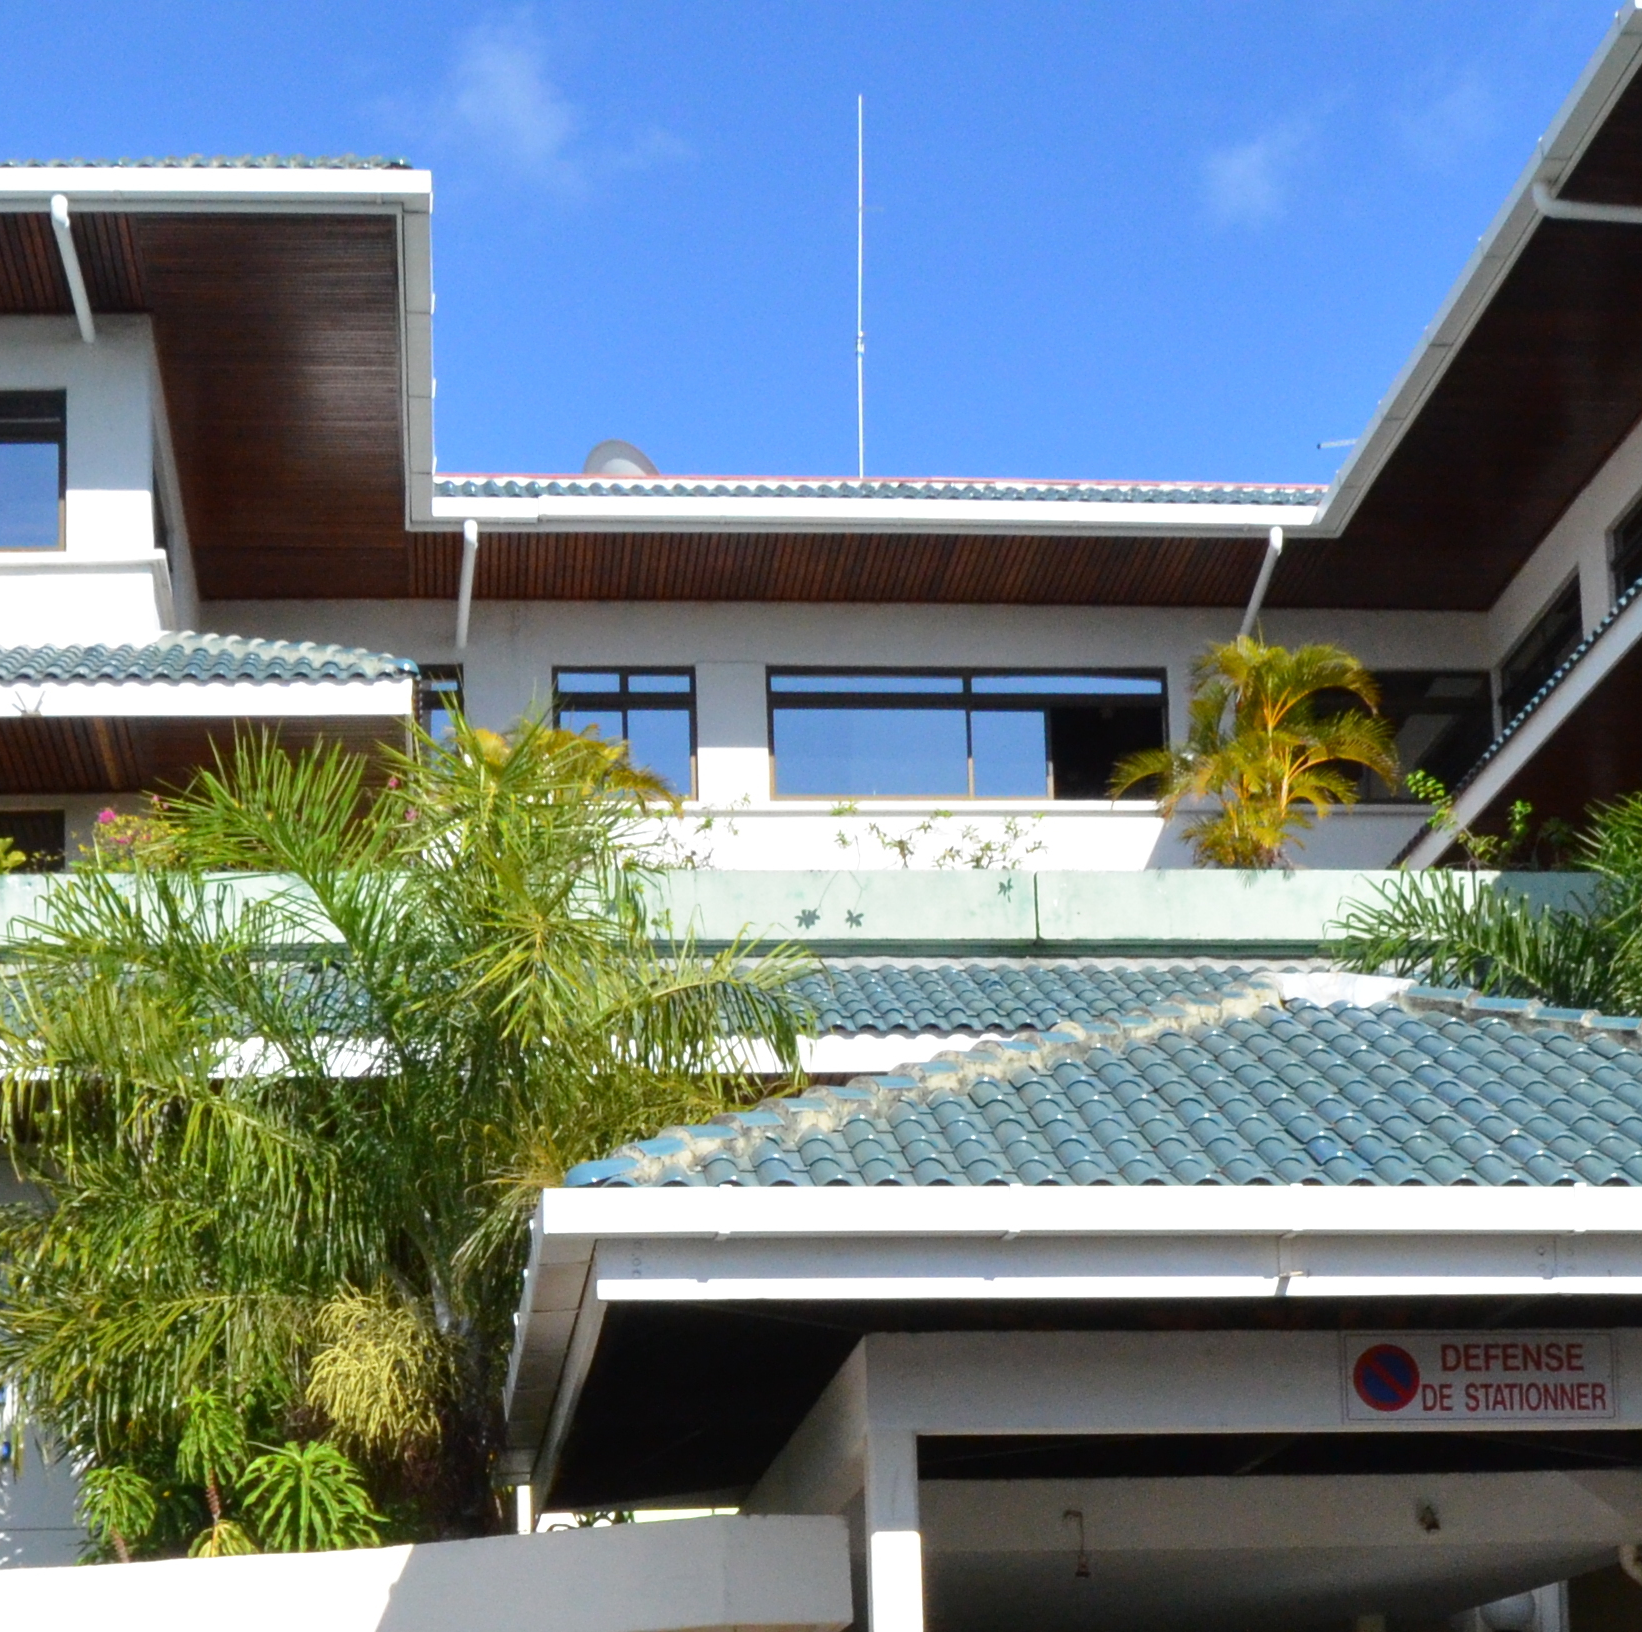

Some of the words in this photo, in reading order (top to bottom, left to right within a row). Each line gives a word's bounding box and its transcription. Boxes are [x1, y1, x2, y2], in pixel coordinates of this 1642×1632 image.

[1440, 1342, 1585, 1373] DEFENSE
[1421, 1383, 1454, 1412] DE
[1464, 1382, 1607, 1412] STATIONNER
